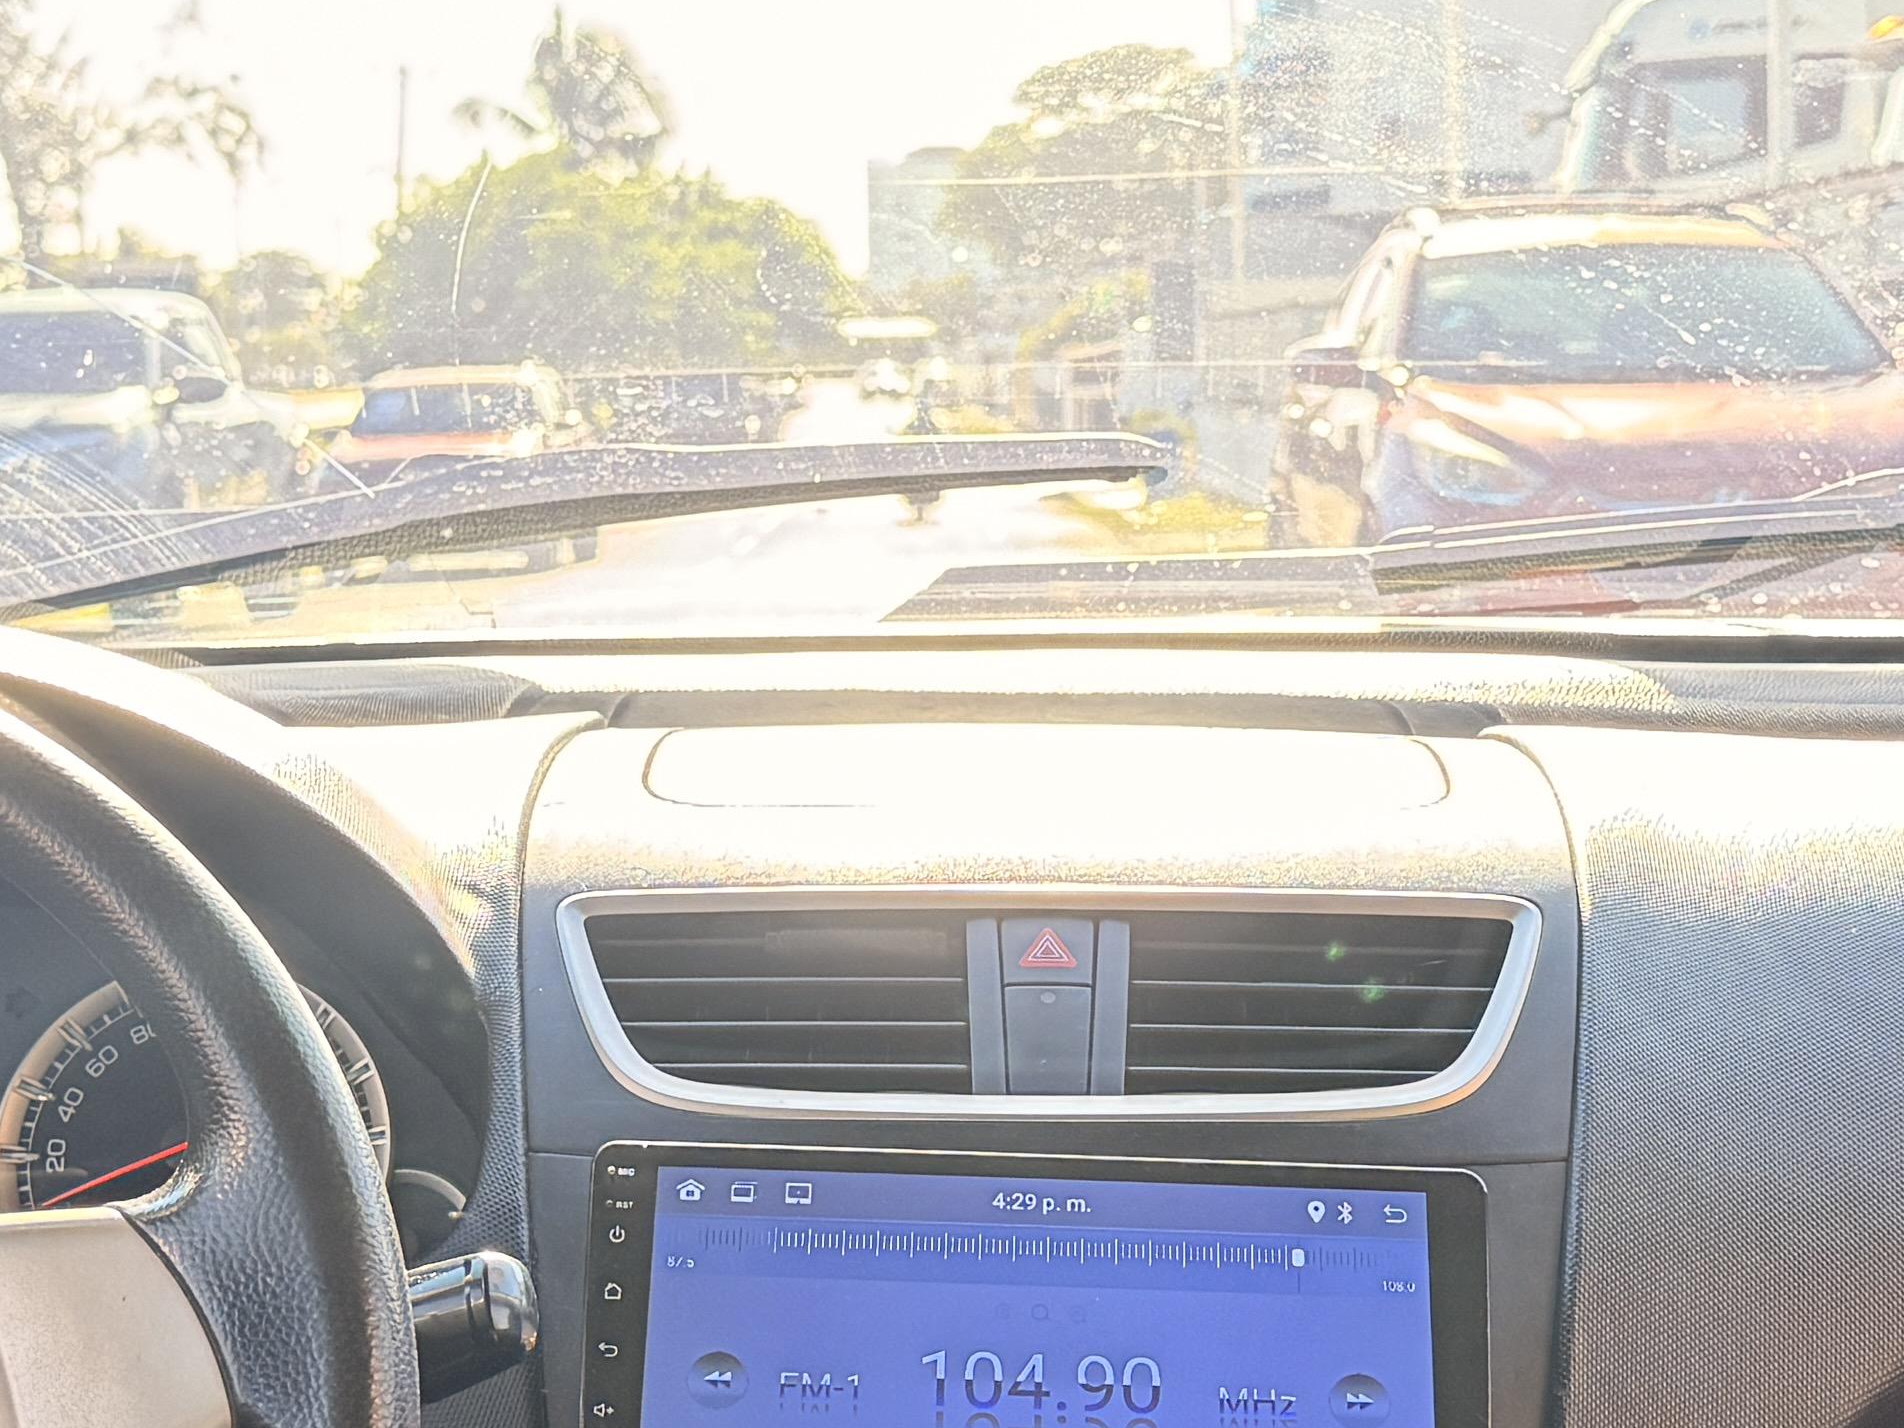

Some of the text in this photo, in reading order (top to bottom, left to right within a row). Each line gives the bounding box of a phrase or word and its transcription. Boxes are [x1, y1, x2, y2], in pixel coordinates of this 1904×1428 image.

[84, 1045, 119, 1078] 60
[57, 1086, 84, 1123] 40
[45, 1138, 66, 1173] 20
[992, 1192, 1037, 1211] 4:29
[778, 1349, 1297, 1416] FM-1 104.90 MHz
